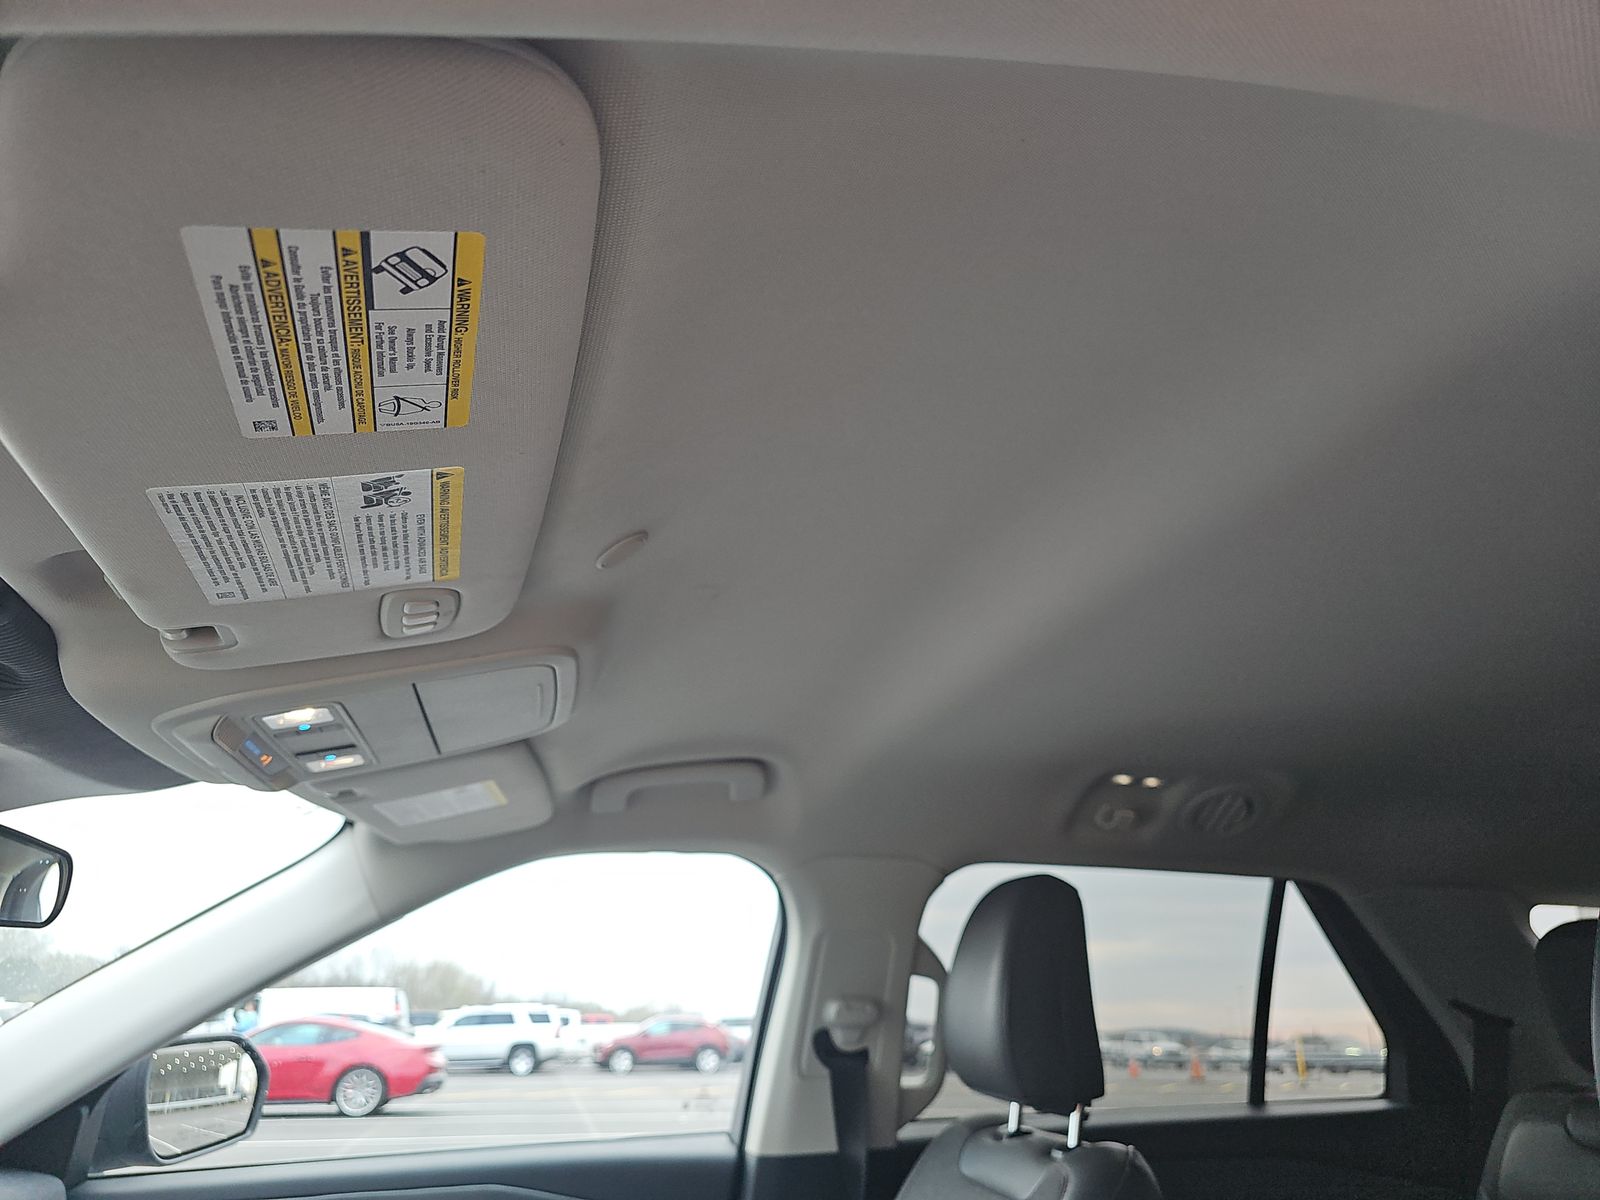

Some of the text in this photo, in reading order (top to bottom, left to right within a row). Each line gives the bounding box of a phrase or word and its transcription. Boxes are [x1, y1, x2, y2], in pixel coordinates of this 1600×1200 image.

[262, 271, 293, 346] ADVERTENCIA:
[340, 259, 365, 346] AVERTISSEMENT:
[454, 288, 471, 335] WARNING:
[404, 327, 415, 345] Always
[424, 334, 433, 357] Excessive
[435, 319, 446, 375] Avoid Abrupt Maneuvers
[278, 348, 292, 369] MAYOR
[350, 348, 361, 369] RISQUE
[374, 321, 387, 377] For Further Information
[387, 325, 398, 373] See Owner's Manual
[406, 346, 415, 362] Buckle
[452, 337, 462, 359] HIGHER
[283, 370, 296, 390] RIESGO
[352, 370, 363, 388] ACCRU
[451, 360, 460, 387] ROLLOVER
[289, 399, 302, 420] VUELCO
[355, 397, 366, 425] CAPOTAGE
